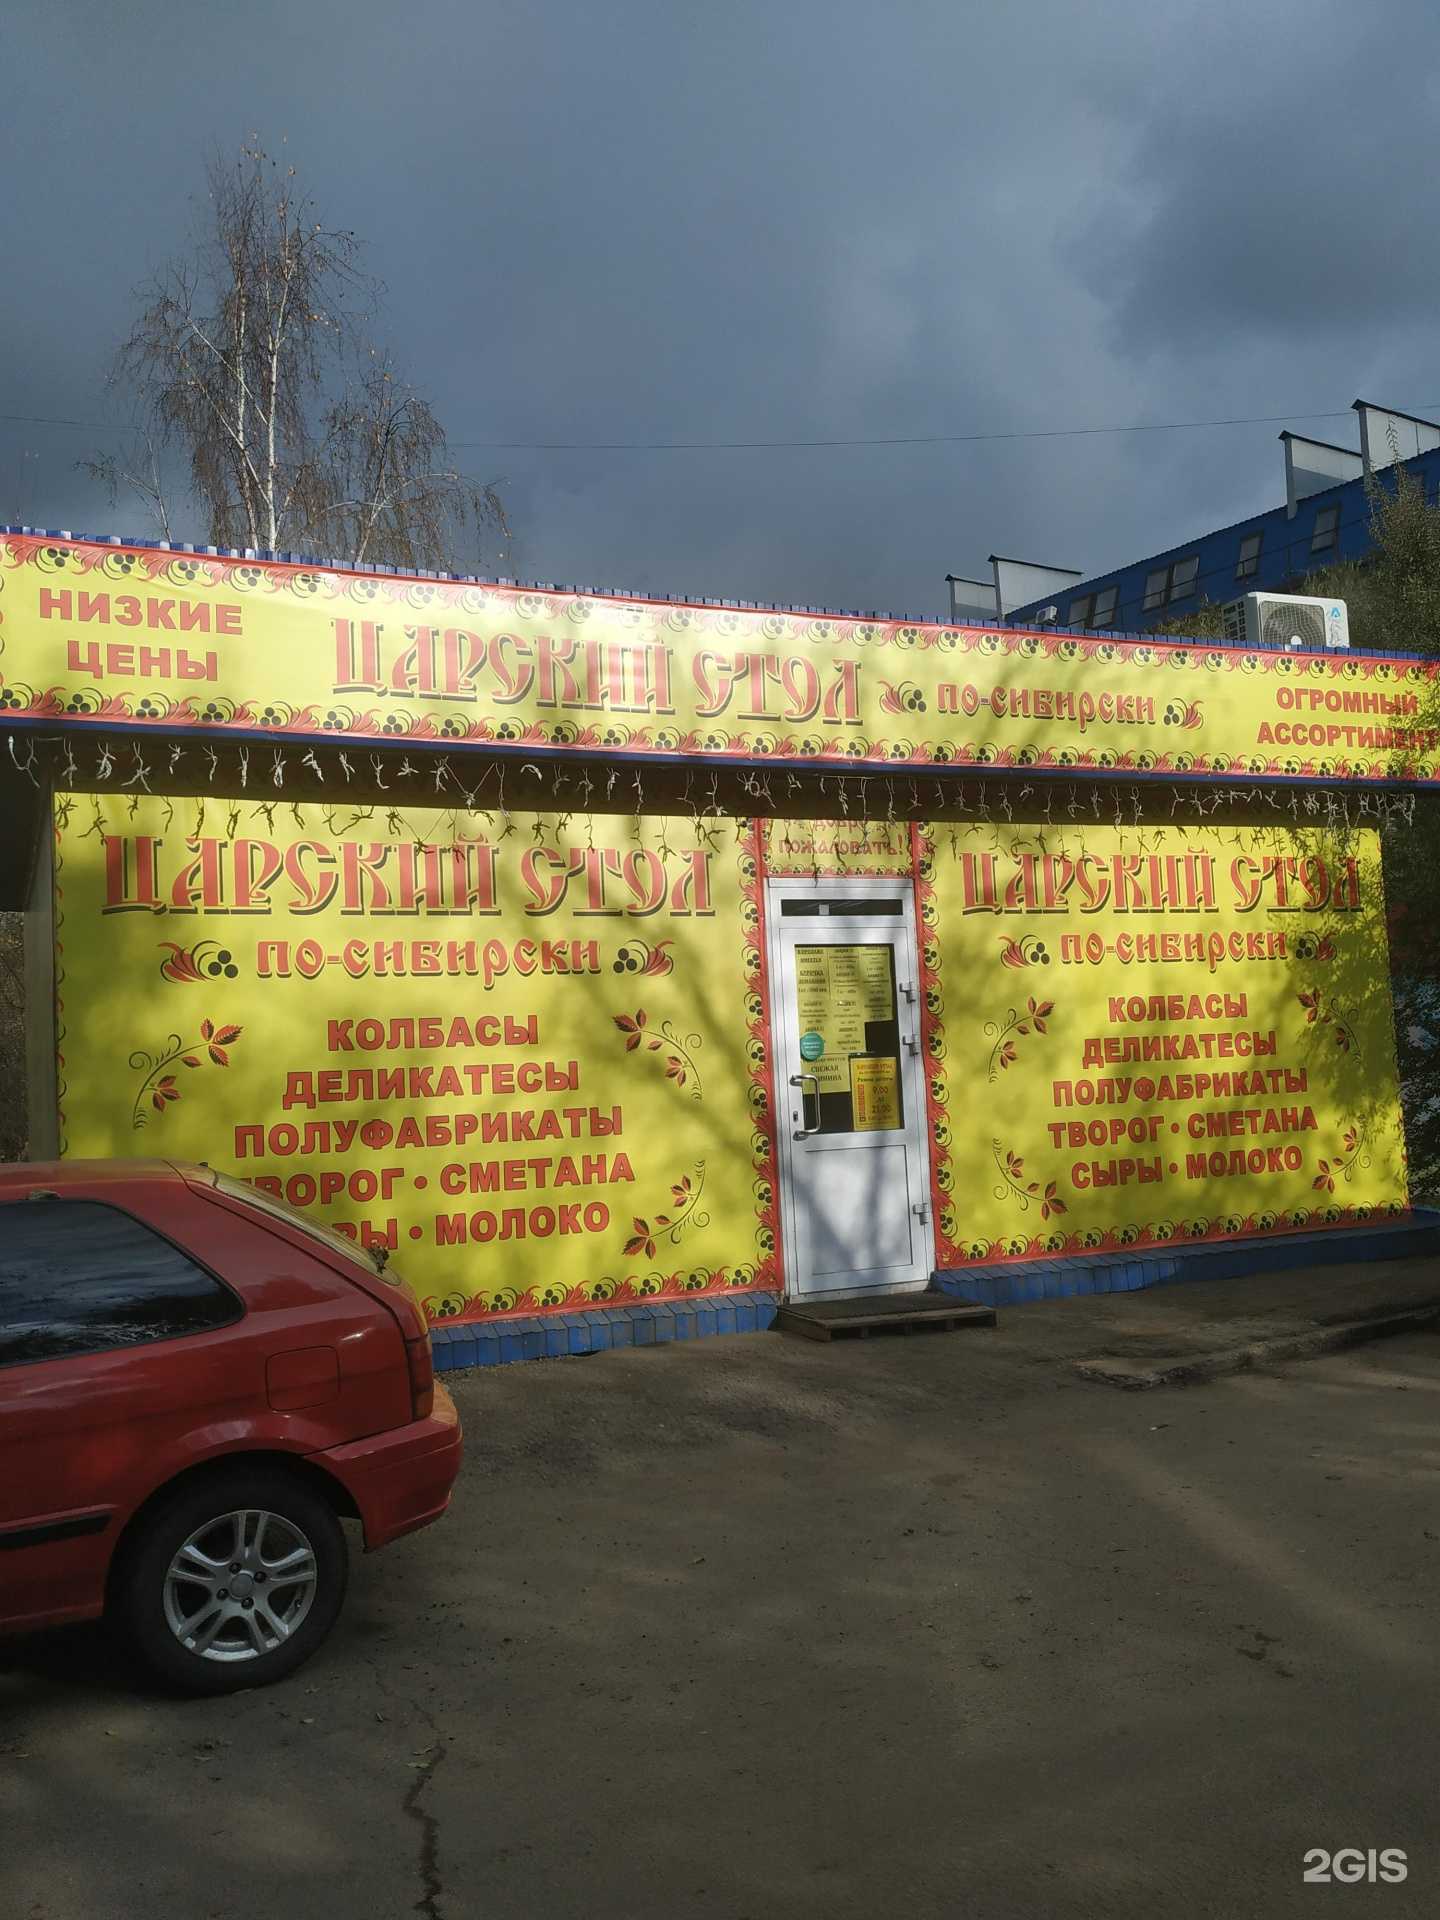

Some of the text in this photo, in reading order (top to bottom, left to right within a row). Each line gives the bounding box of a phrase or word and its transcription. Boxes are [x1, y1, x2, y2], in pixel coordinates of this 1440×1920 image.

[39, 587, 243, 636] НИЗКИЕ
[67, 639, 218, 682] ЦЕНЫ
[329, 617, 676, 716] ЦАРСКИЙ
[693, 647, 865, 726] СТОЛ
[1276, 687, 1418, 715] ОГРОМНЫЙ
[1257, 722, 1438, 751] АССОРТИМЕНТ
[101, 833, 716, 917] ЦАРСКИЙ СТОЛ
[960, 847, 1363, 916] ЦАРСКИЙ СТОЛ
[1109, 993, 1248, 1023] КОЛБАСЫ
[327, 1014, 538, 1052] КОЛБАСЫ
[1082, 1031, 1277, 1070] ДЕЛИКАТЕСЫ
[282, 1061, 579, 1110] ДЕЛИКАТЕСЫ
[1053, 1069, 1307, 1107] ПОЛУФАБРИКАТЫ
[234, 1105, 622, 1159] ПОЛУФАБРИКАТЫ
[1048, 1107, 1318, 1149] ТВОРОГ СМЕТАНА
[239, 1153, 634, 1206] ВОРОГ СМЕТАНА
[1071, 1145, 1303, 1189] СЫРЫ МОЛОКО
[435, 1201, 611, 1247] МОЛОКО
